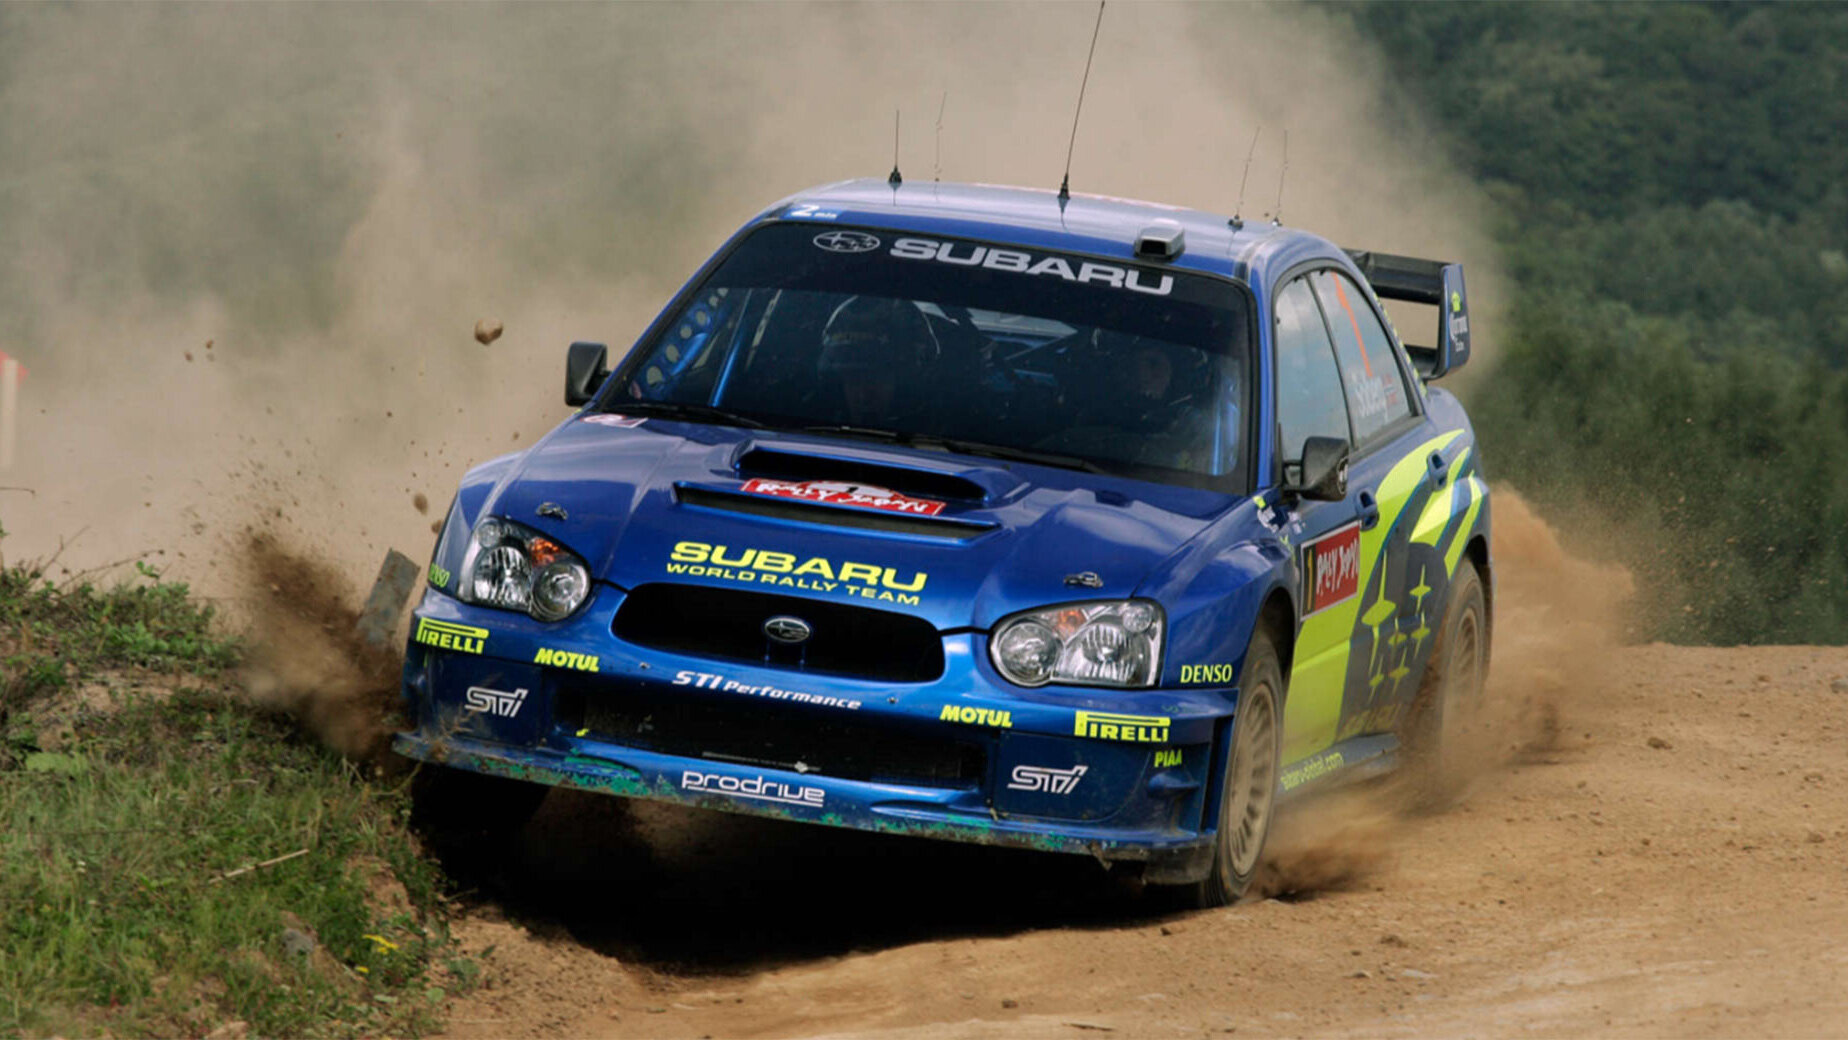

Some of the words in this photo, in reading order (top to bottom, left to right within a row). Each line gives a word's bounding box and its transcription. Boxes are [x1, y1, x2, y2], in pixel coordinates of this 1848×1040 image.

[890, 238, 1173, 296] SUBARU
[670, 541, 928, 592] SUBARU
[666, 563, 756, 581] WORLD
[760, 573, 838, 592] RALLY
[846, 584, 920, 606] TEAM
[416, 617, 489, 654] PIRELLI
[534, 648, 600, 672] MOTUL
[1180, 664, 1232, 683] DENSO
[672, 670, 723, 690] STI
[723, 680, 862, 710] Performance
[940, 705, 1012, 728] MOTUL
[1074, 710, 1171, 742] PIRELLI
[1154, 749, 1182, 768] PIAA
[682, 770, 825, 804] prodrive
